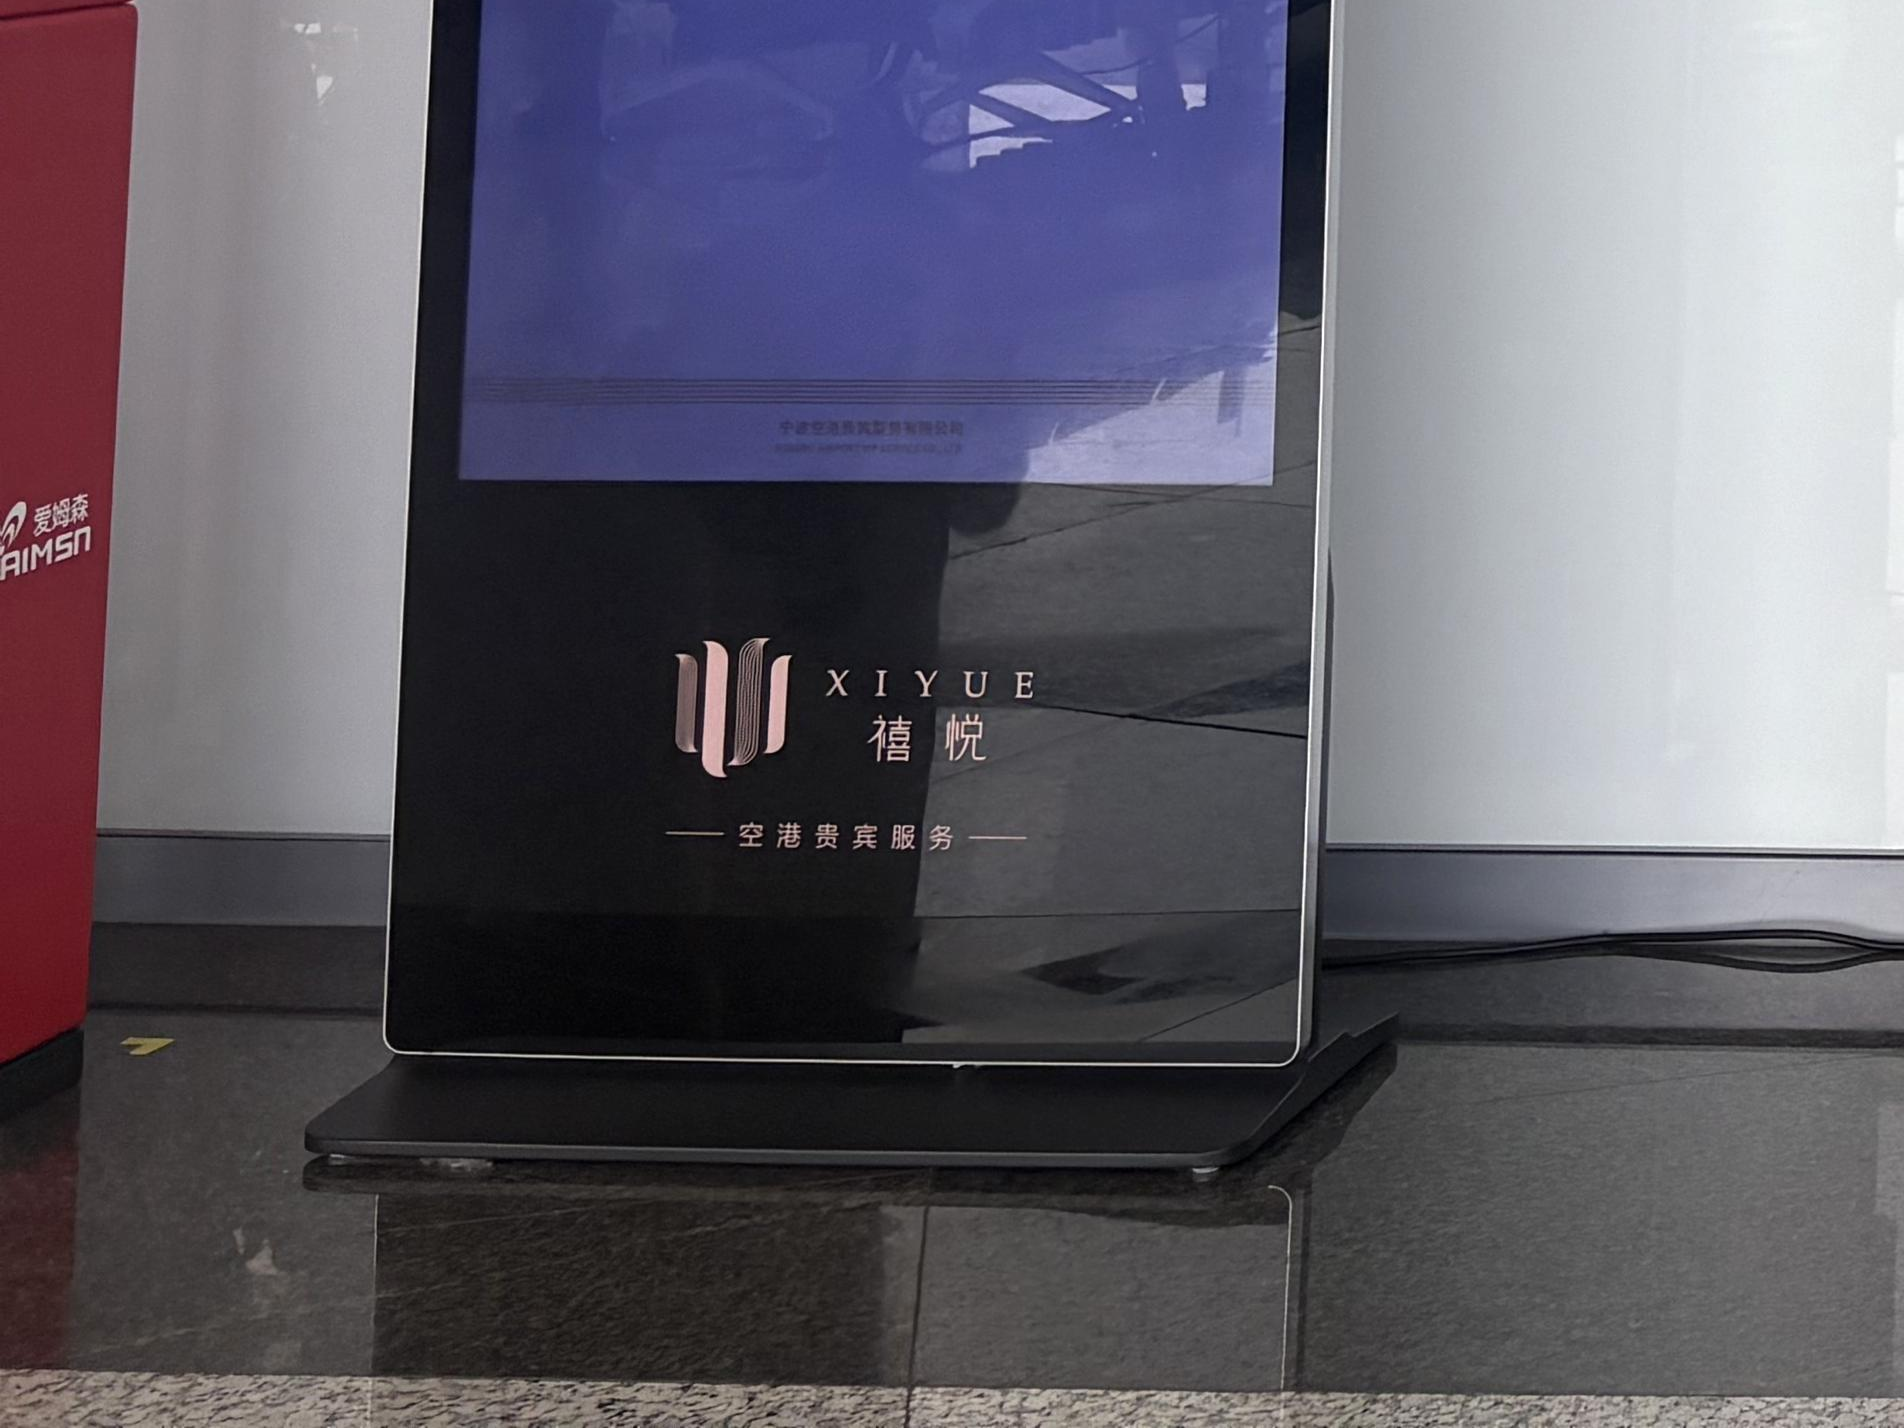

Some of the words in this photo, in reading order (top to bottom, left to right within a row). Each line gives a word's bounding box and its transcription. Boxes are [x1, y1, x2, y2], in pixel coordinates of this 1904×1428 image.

[826, 668, 1037, 700] XIYUE
[867, 713, 987, 764] 禧悦
[738, 821, 957, 852] 空港贵宾服务
